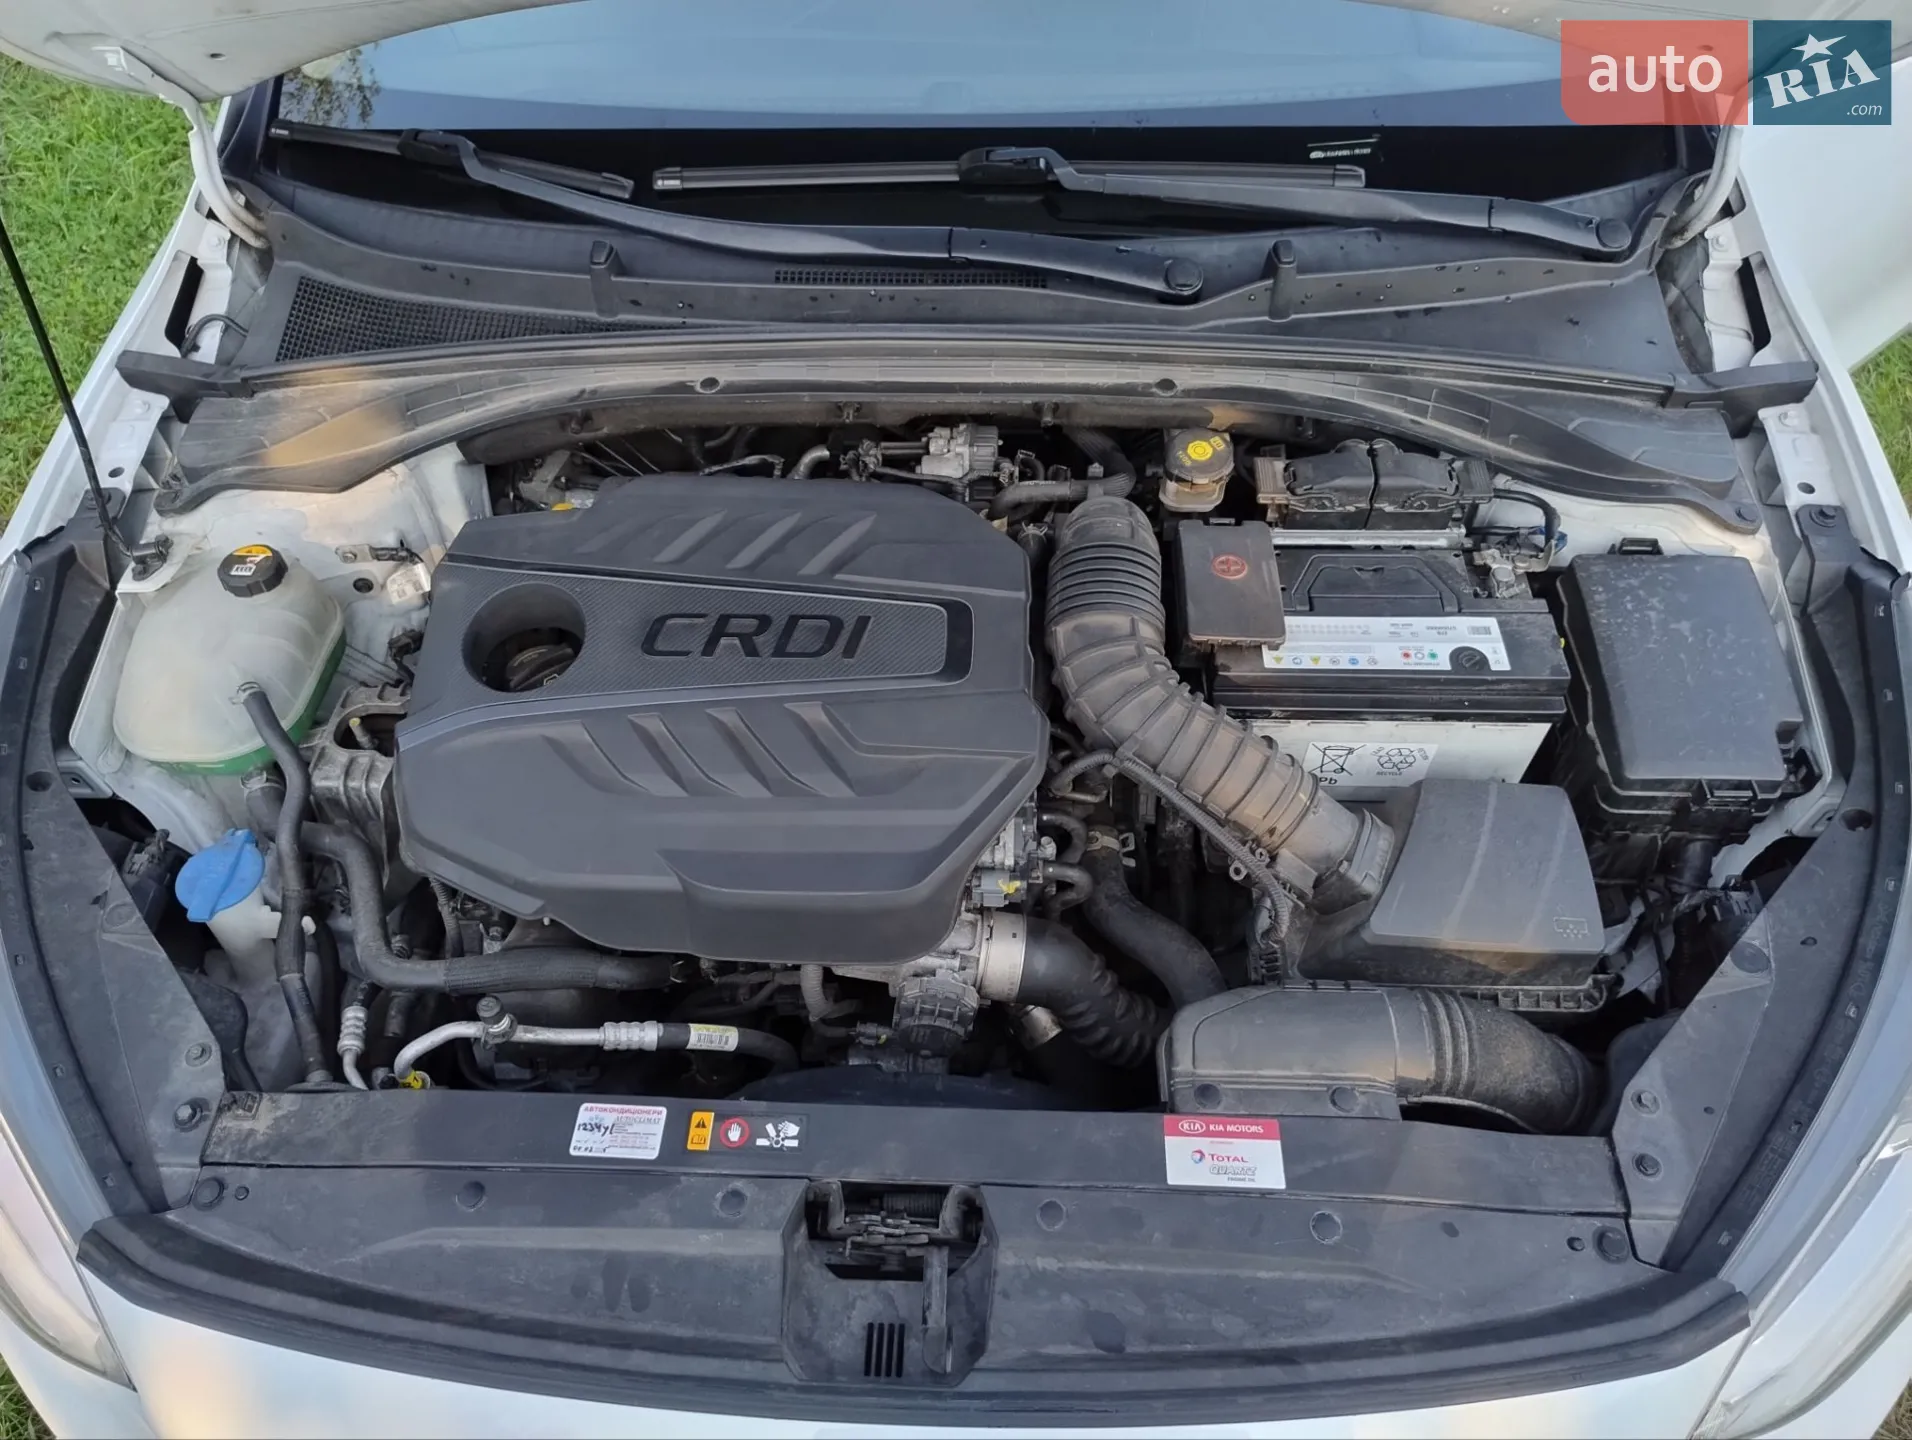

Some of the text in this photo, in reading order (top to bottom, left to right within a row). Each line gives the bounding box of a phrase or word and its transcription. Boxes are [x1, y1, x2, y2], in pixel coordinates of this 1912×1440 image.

[640, 613, 873, 660] CRDI
[1183, 1122, 1202, 1131] KIA
[1209, 1124, 1264, 1133] KIA MOTORS
[1208, 1153, 1249, 1163] TOTAL
[1209, 1163, 1257, 1177] QUARTZ
